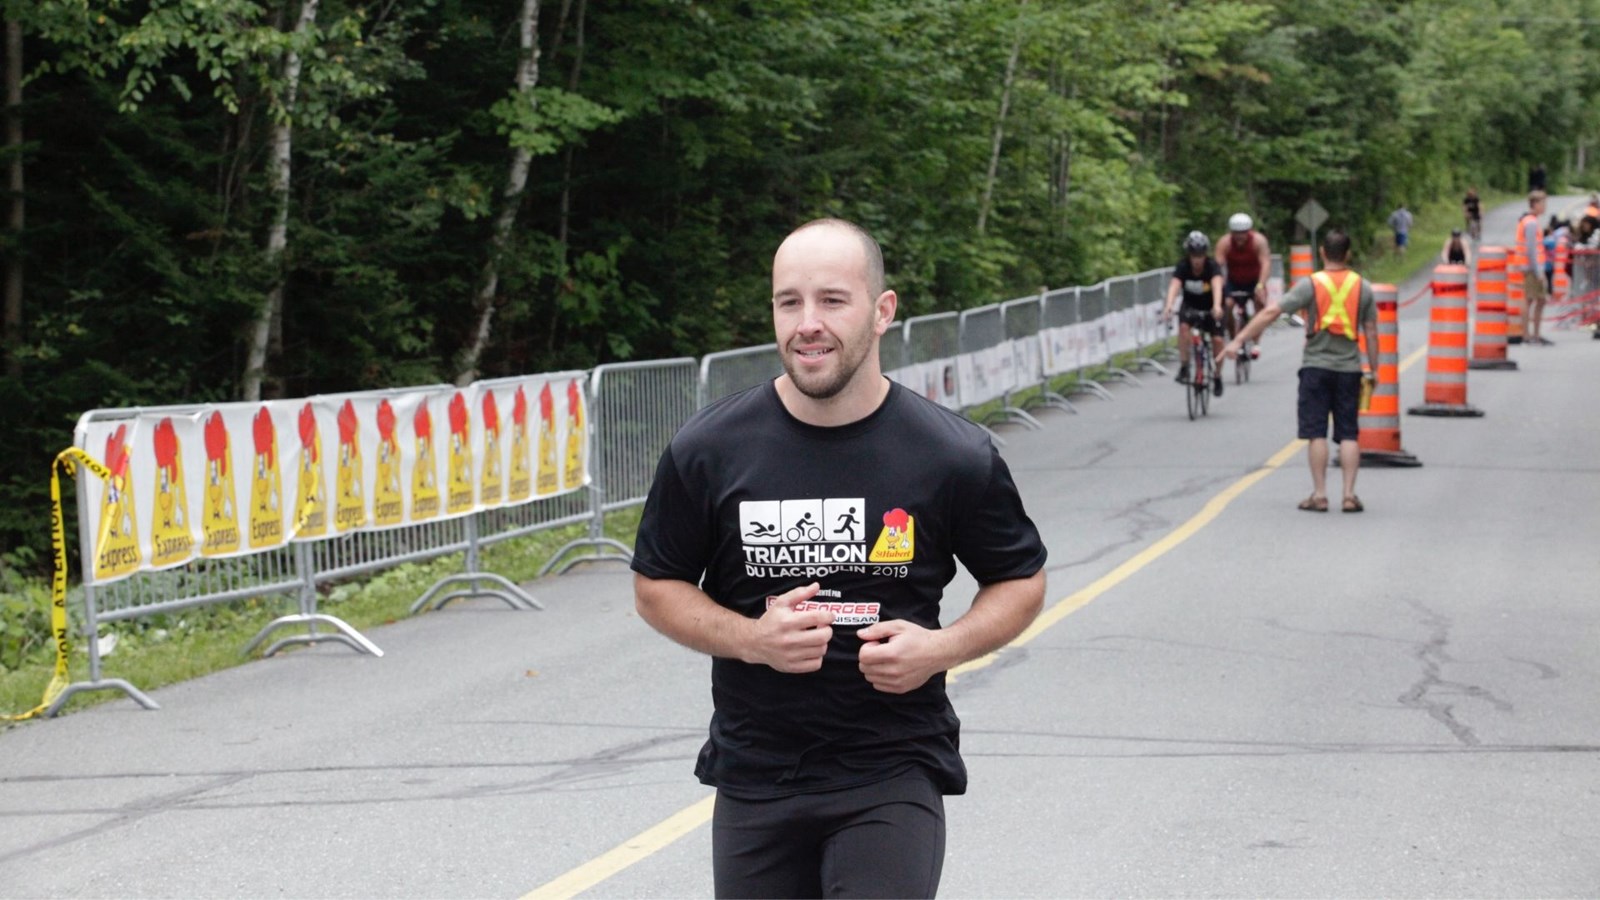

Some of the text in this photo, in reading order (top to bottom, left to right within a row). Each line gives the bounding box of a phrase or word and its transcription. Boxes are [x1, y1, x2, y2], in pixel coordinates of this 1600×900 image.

[205, 525, 238, 550] Express
[252, 517, 281, 541] Express
[155, 533, 191, 559] Express
[743, 544, 867, 563] TRIATHLON
[746, 564, 908, 579] DU LAC-POULIN 2019
